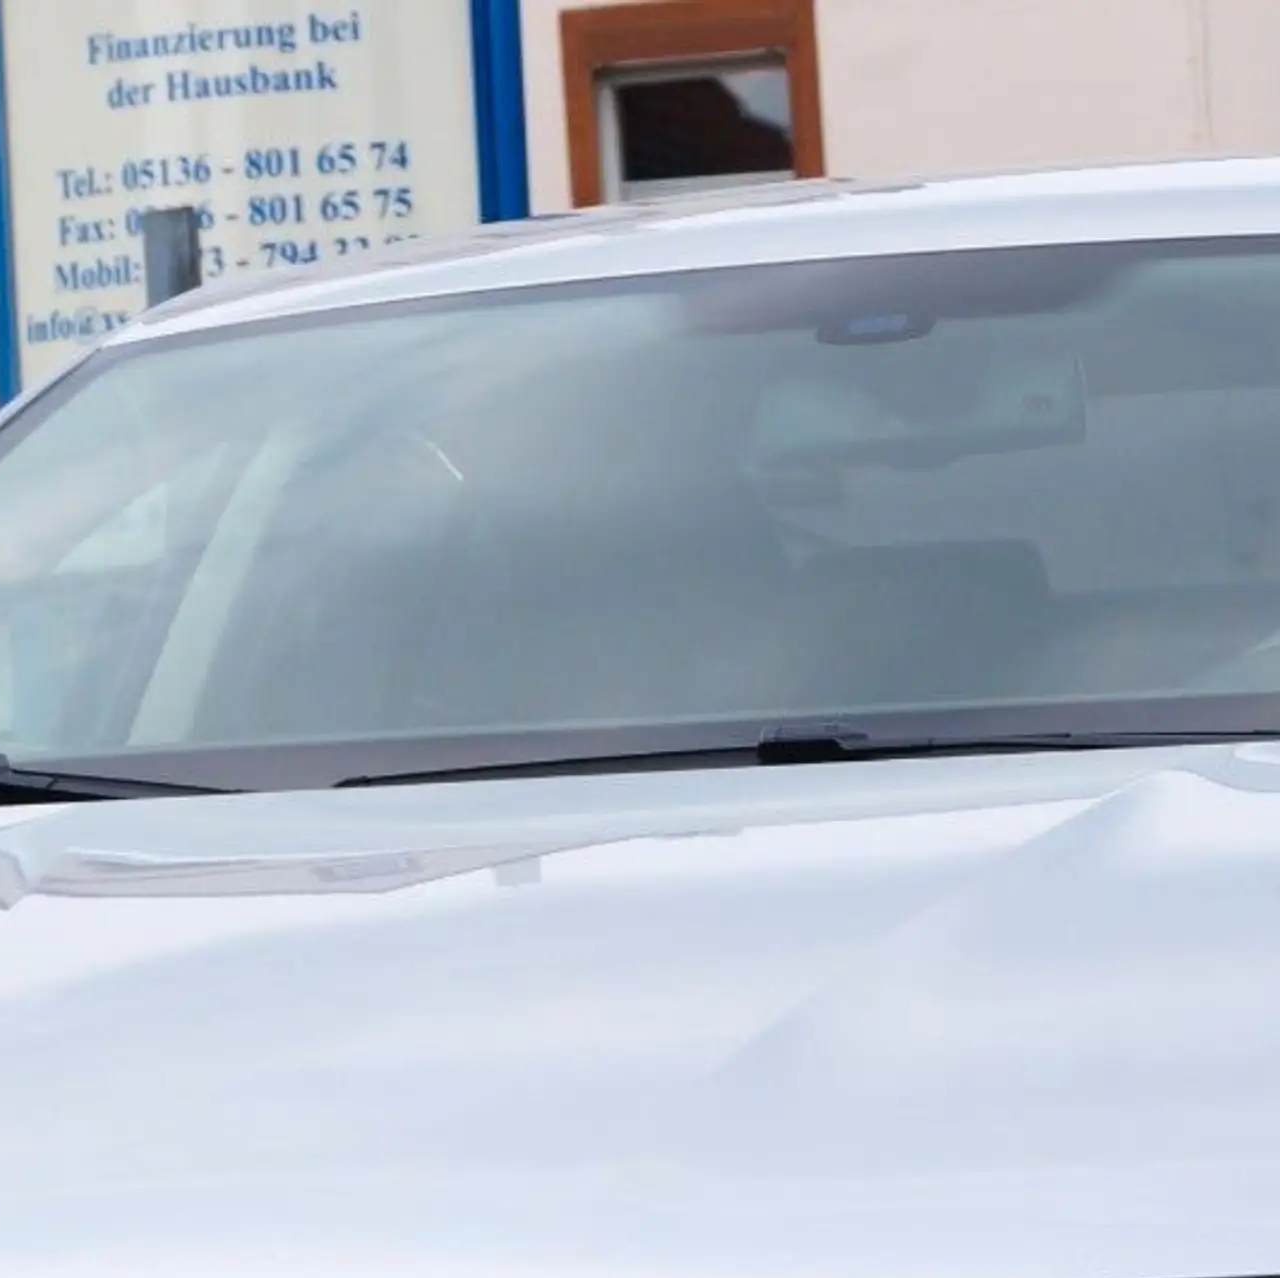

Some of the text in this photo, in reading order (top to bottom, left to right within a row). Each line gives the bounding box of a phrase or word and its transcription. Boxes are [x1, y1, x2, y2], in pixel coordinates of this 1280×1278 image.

[86, 12, 361, 66] Finanzierung bei
[106, 61, 338, 110] der Hausbank
[122, 155, 211, 190] 05136
[244, 148, 301, 180] 801
[317, 143, 357, 175] 65
[370, 141, 408, 171] 74
[58, 214, 116, 247] Fax:
[248, 194, 306, 226] 801
[321, 190, 361, 221] 65
[374, 187, 413, 219] 75
[54, 255, 141, 290] Mobil:
